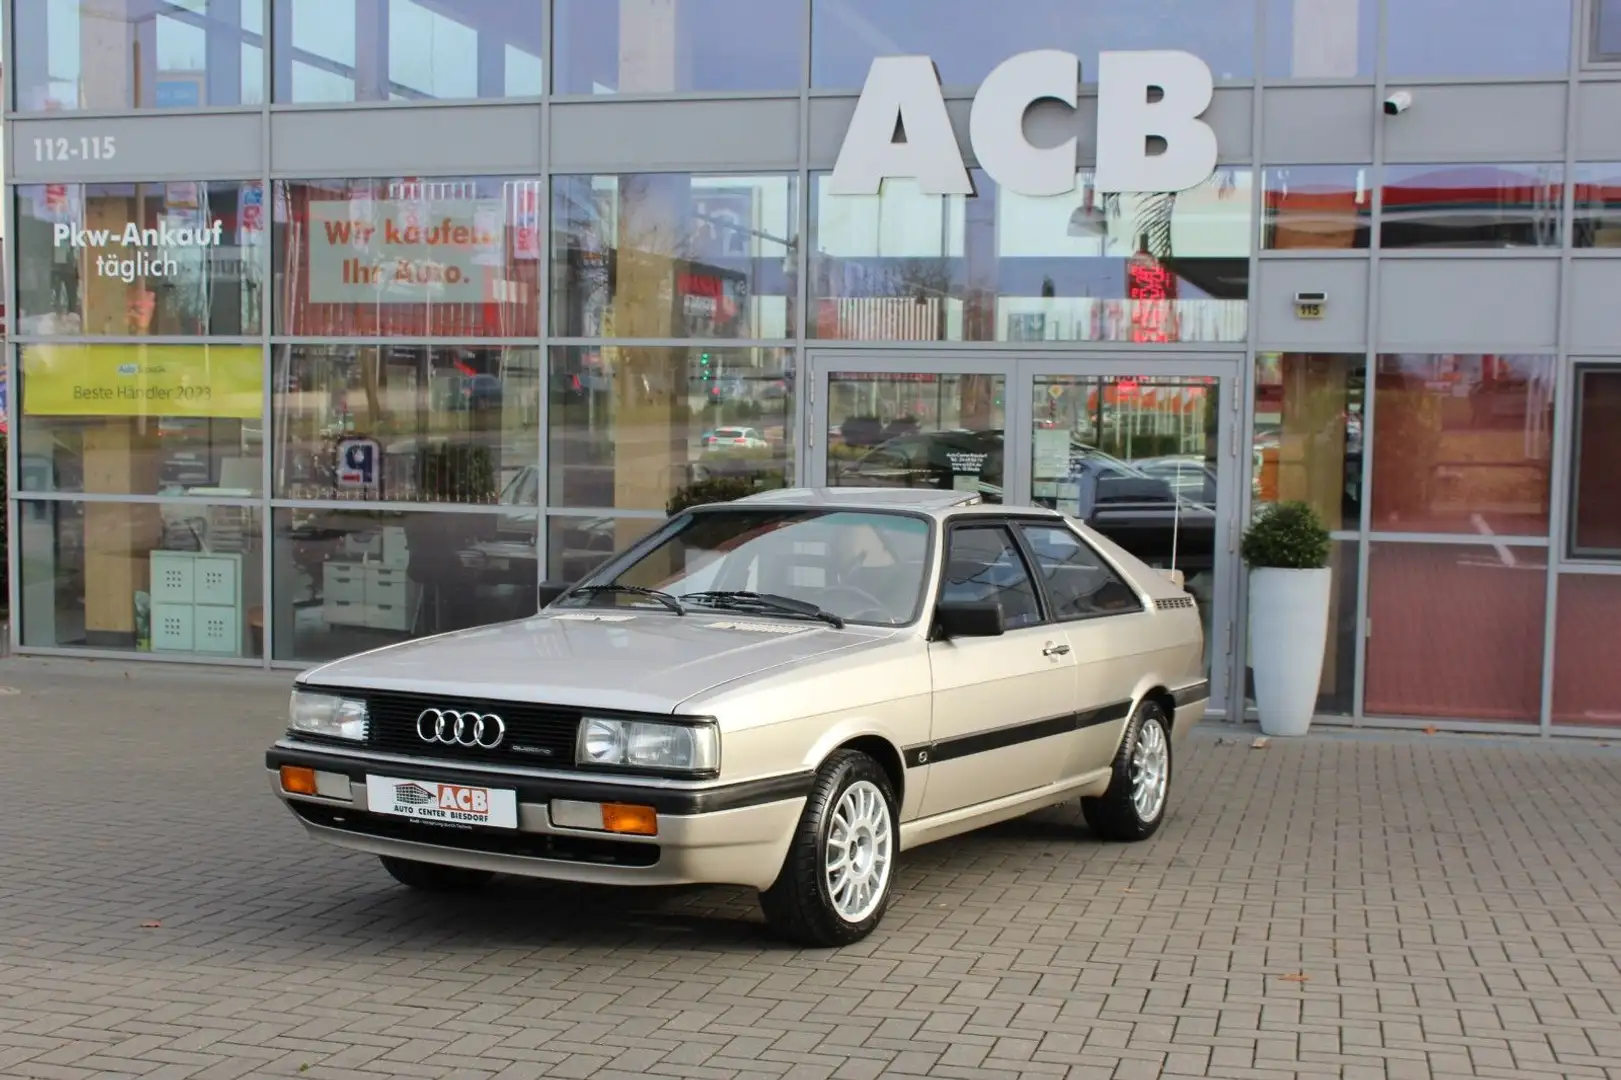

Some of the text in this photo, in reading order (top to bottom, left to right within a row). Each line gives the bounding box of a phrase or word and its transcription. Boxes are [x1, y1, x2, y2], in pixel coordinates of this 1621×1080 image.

[828, 48, 1218, 196] ACB
[33, 136, 116, 162] 112-115
[53, 219, 223, 247] Pkw-Ankauf
[324, 219, 376, 245] Wir
[95, 250, 178, 283] täglich
[73, 385, 114, 400] Beste
[116, 384, 172, 400] Händler
[439, 786, 488, 812] ACB
[393, 804, 489, 823] AUTO CENTER BIESDORF
